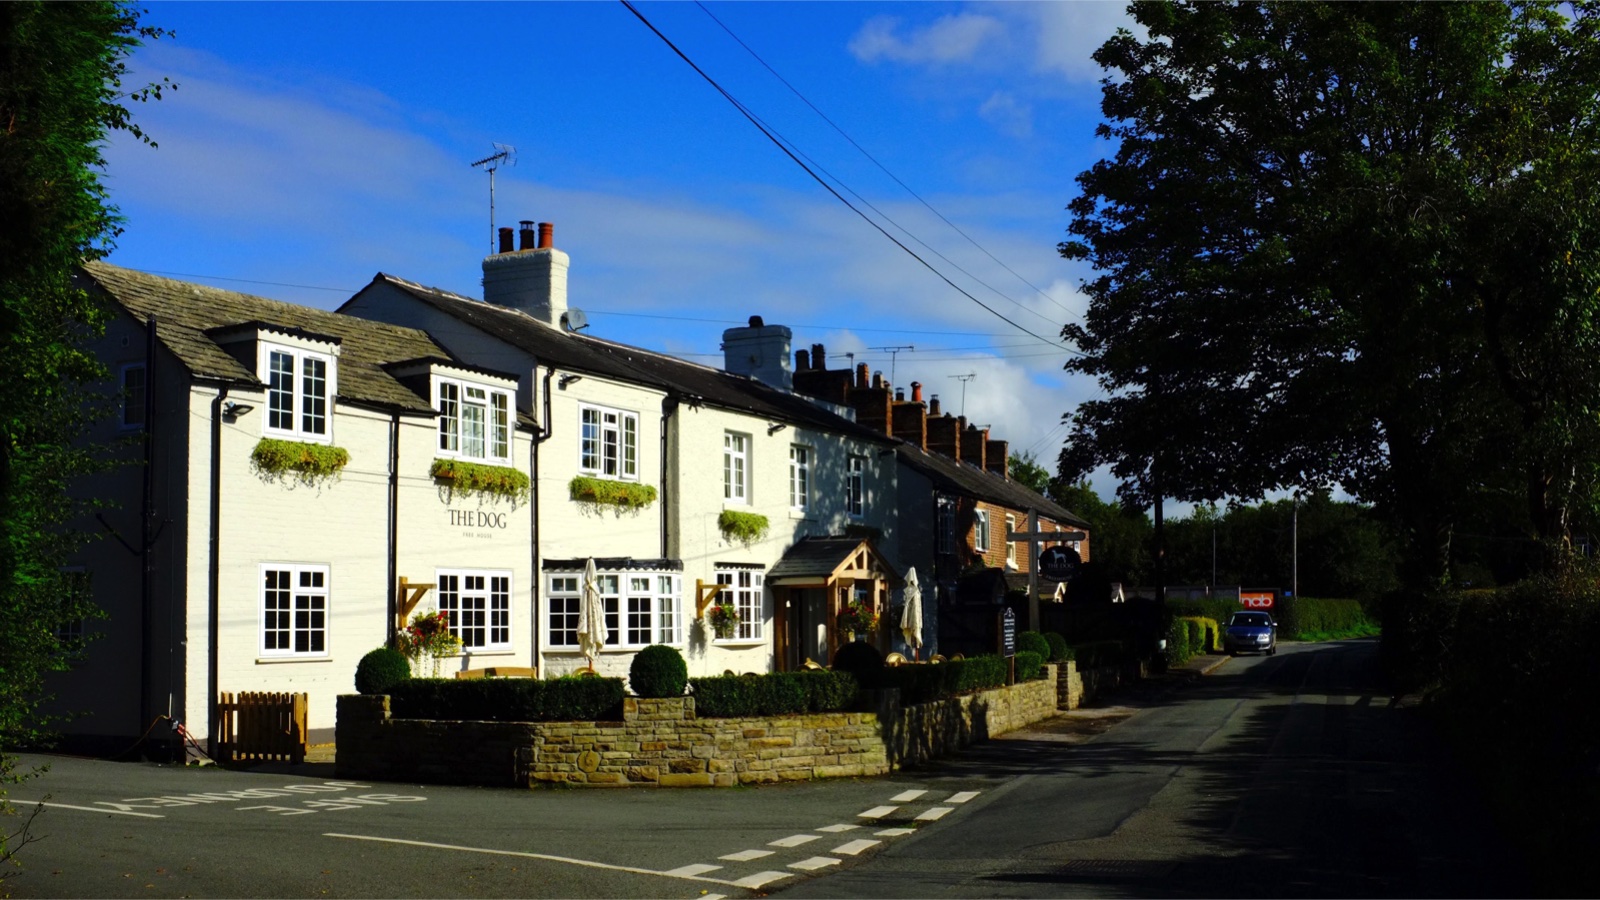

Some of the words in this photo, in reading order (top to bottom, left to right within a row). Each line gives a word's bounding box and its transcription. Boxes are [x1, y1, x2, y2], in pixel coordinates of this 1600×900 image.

[448, 509, 474, 527] THE
[477, 510, 506, 529] DOG
[94, 781, 372, 811] JOURNEY
[234, 793, 428, 816] SAFE
